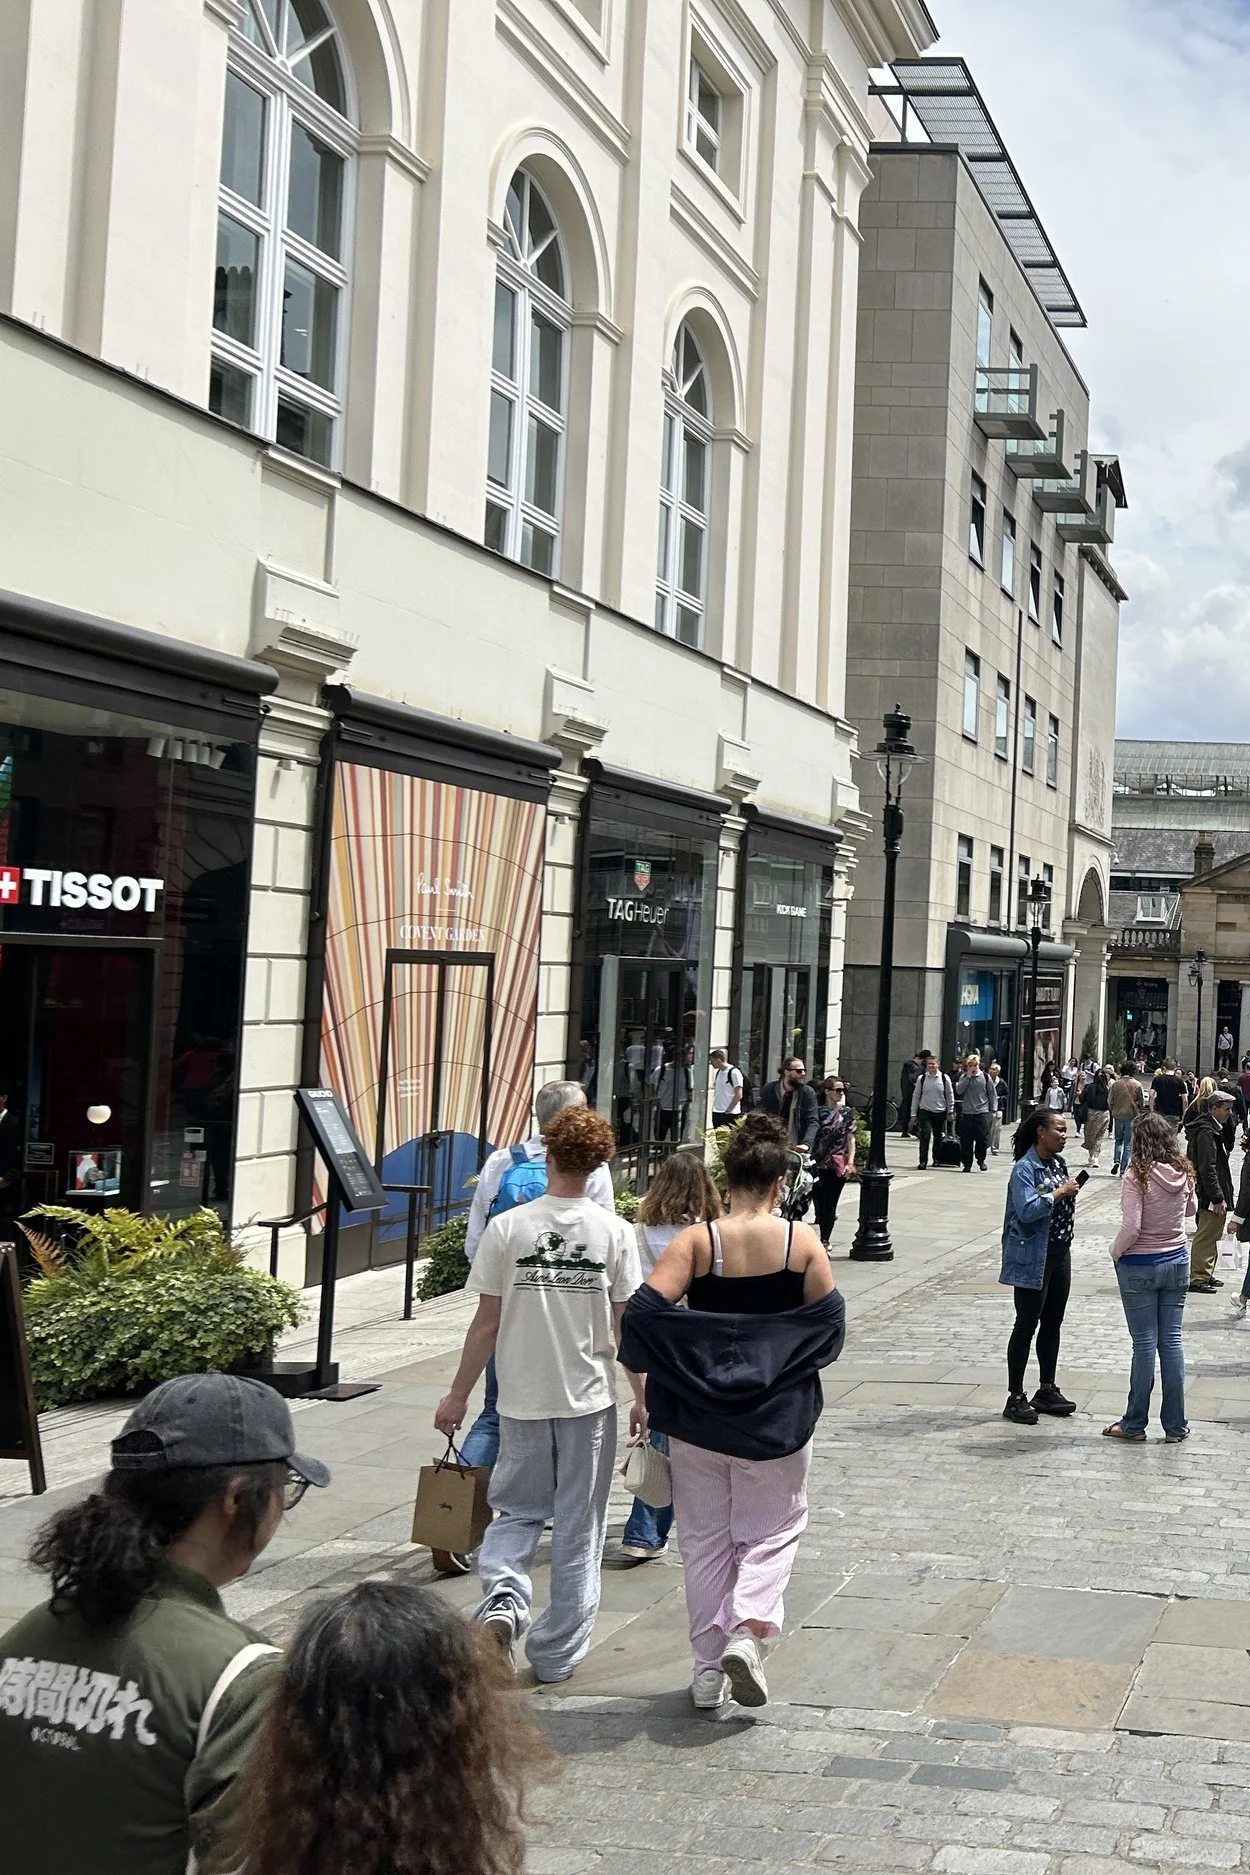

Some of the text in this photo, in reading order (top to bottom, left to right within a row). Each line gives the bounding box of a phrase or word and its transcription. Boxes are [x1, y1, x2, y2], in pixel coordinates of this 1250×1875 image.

[23, 868, 164, 912] TISSOT
[416, 872, 440, 895] Paul
[400, 925, 486, 942] COVENT GARDEN
